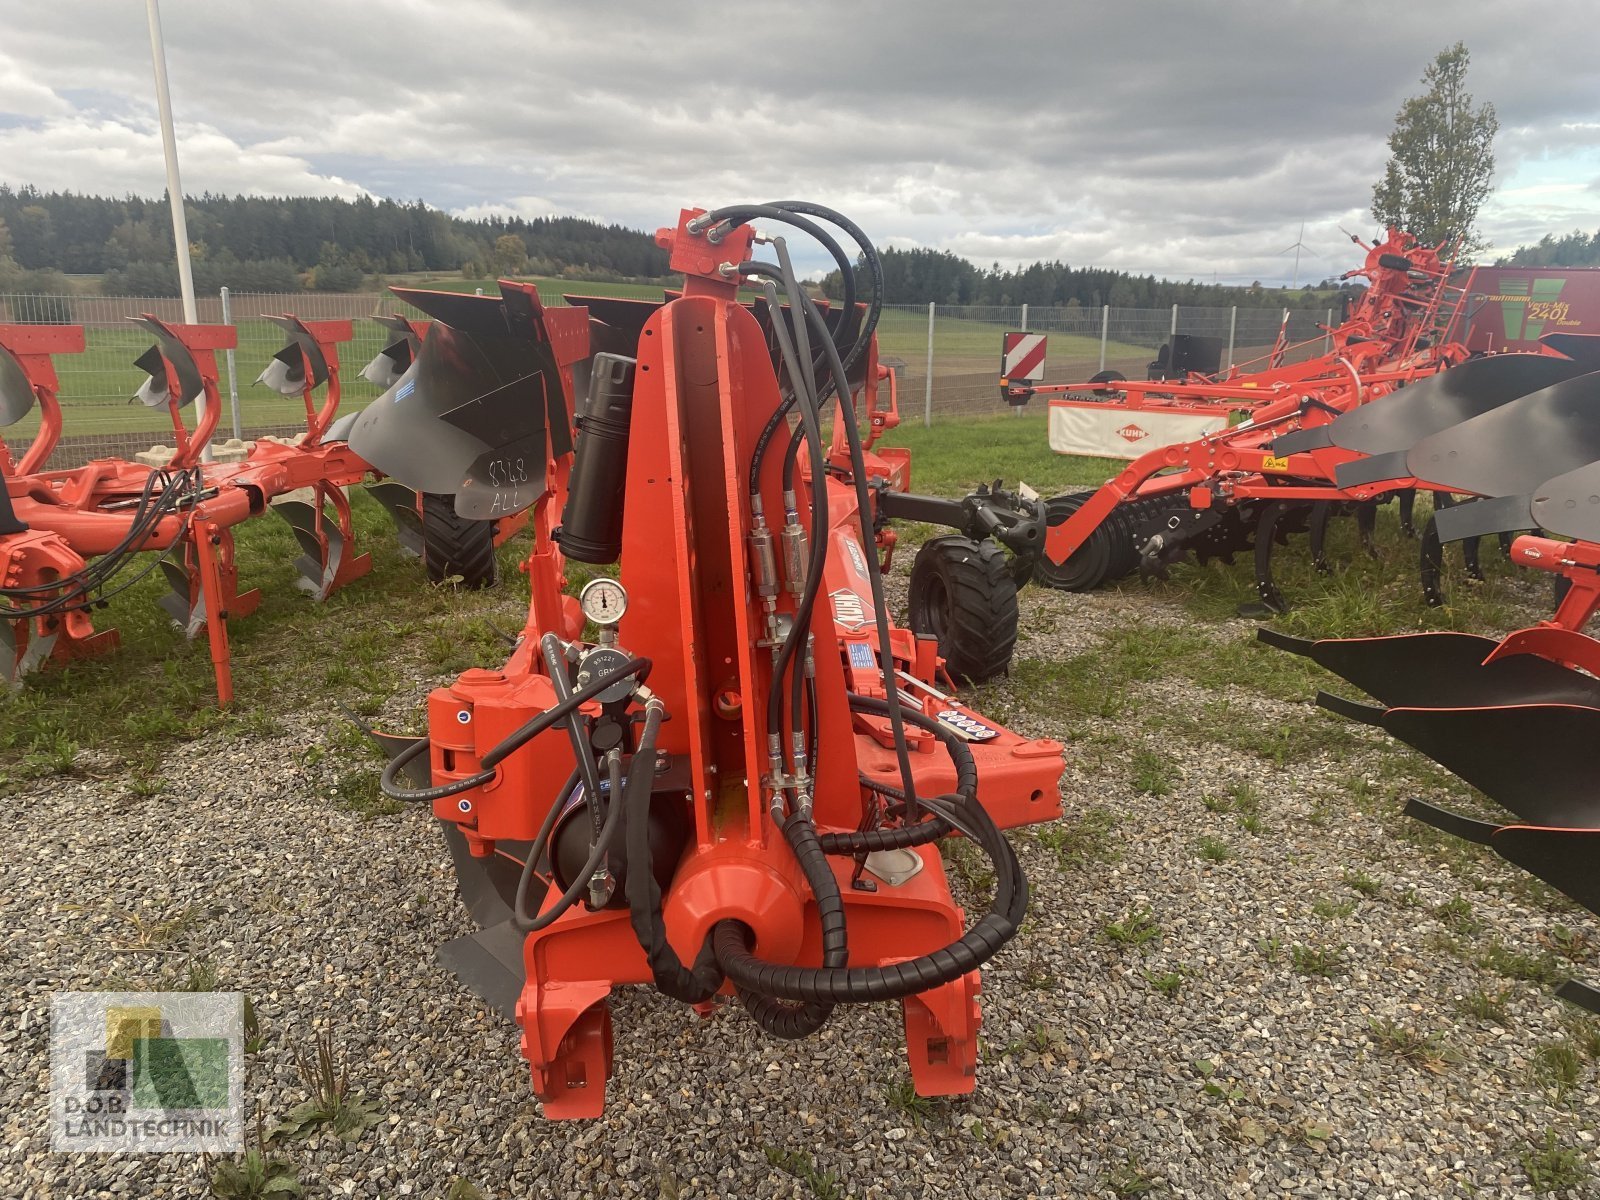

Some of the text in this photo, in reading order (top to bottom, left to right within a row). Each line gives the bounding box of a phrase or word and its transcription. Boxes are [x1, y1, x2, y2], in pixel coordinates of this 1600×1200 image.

[1528, 302, 1570, 310] Verti-Mix
[1527, 308, 1569, 320] 2401
[1120, 429, 1146, 438] KUHN
[489, 457, 528, 489] 8348
[490, 491, 522, 513] ALL
[834, 593, 865, 622] KUHN
[593, 655, 615, 666] 951221
